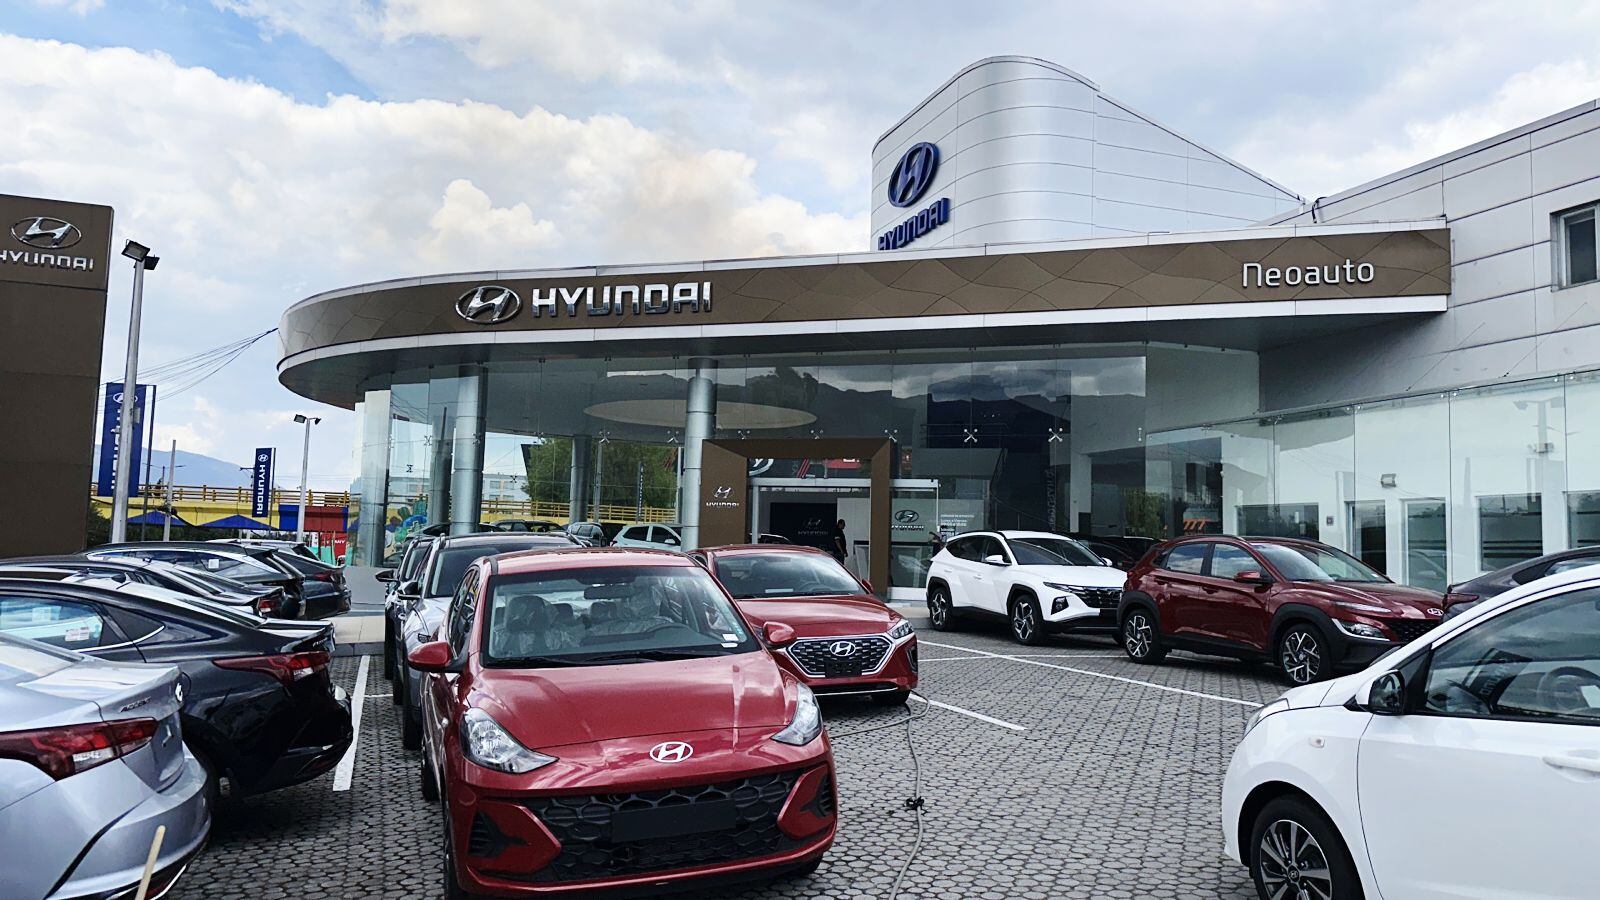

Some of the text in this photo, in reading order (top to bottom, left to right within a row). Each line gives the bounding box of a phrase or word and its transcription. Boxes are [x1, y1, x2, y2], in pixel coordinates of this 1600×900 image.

[878, 197, 950, 250] HYUNDAI
[0, 250, 94, 270] HYUNDAI
[1242, 258, 1374, 288] Neoauto
[532, 281, 712, 317] HYUNDAI
[256, 464, 266, 515] HYUNDAI
